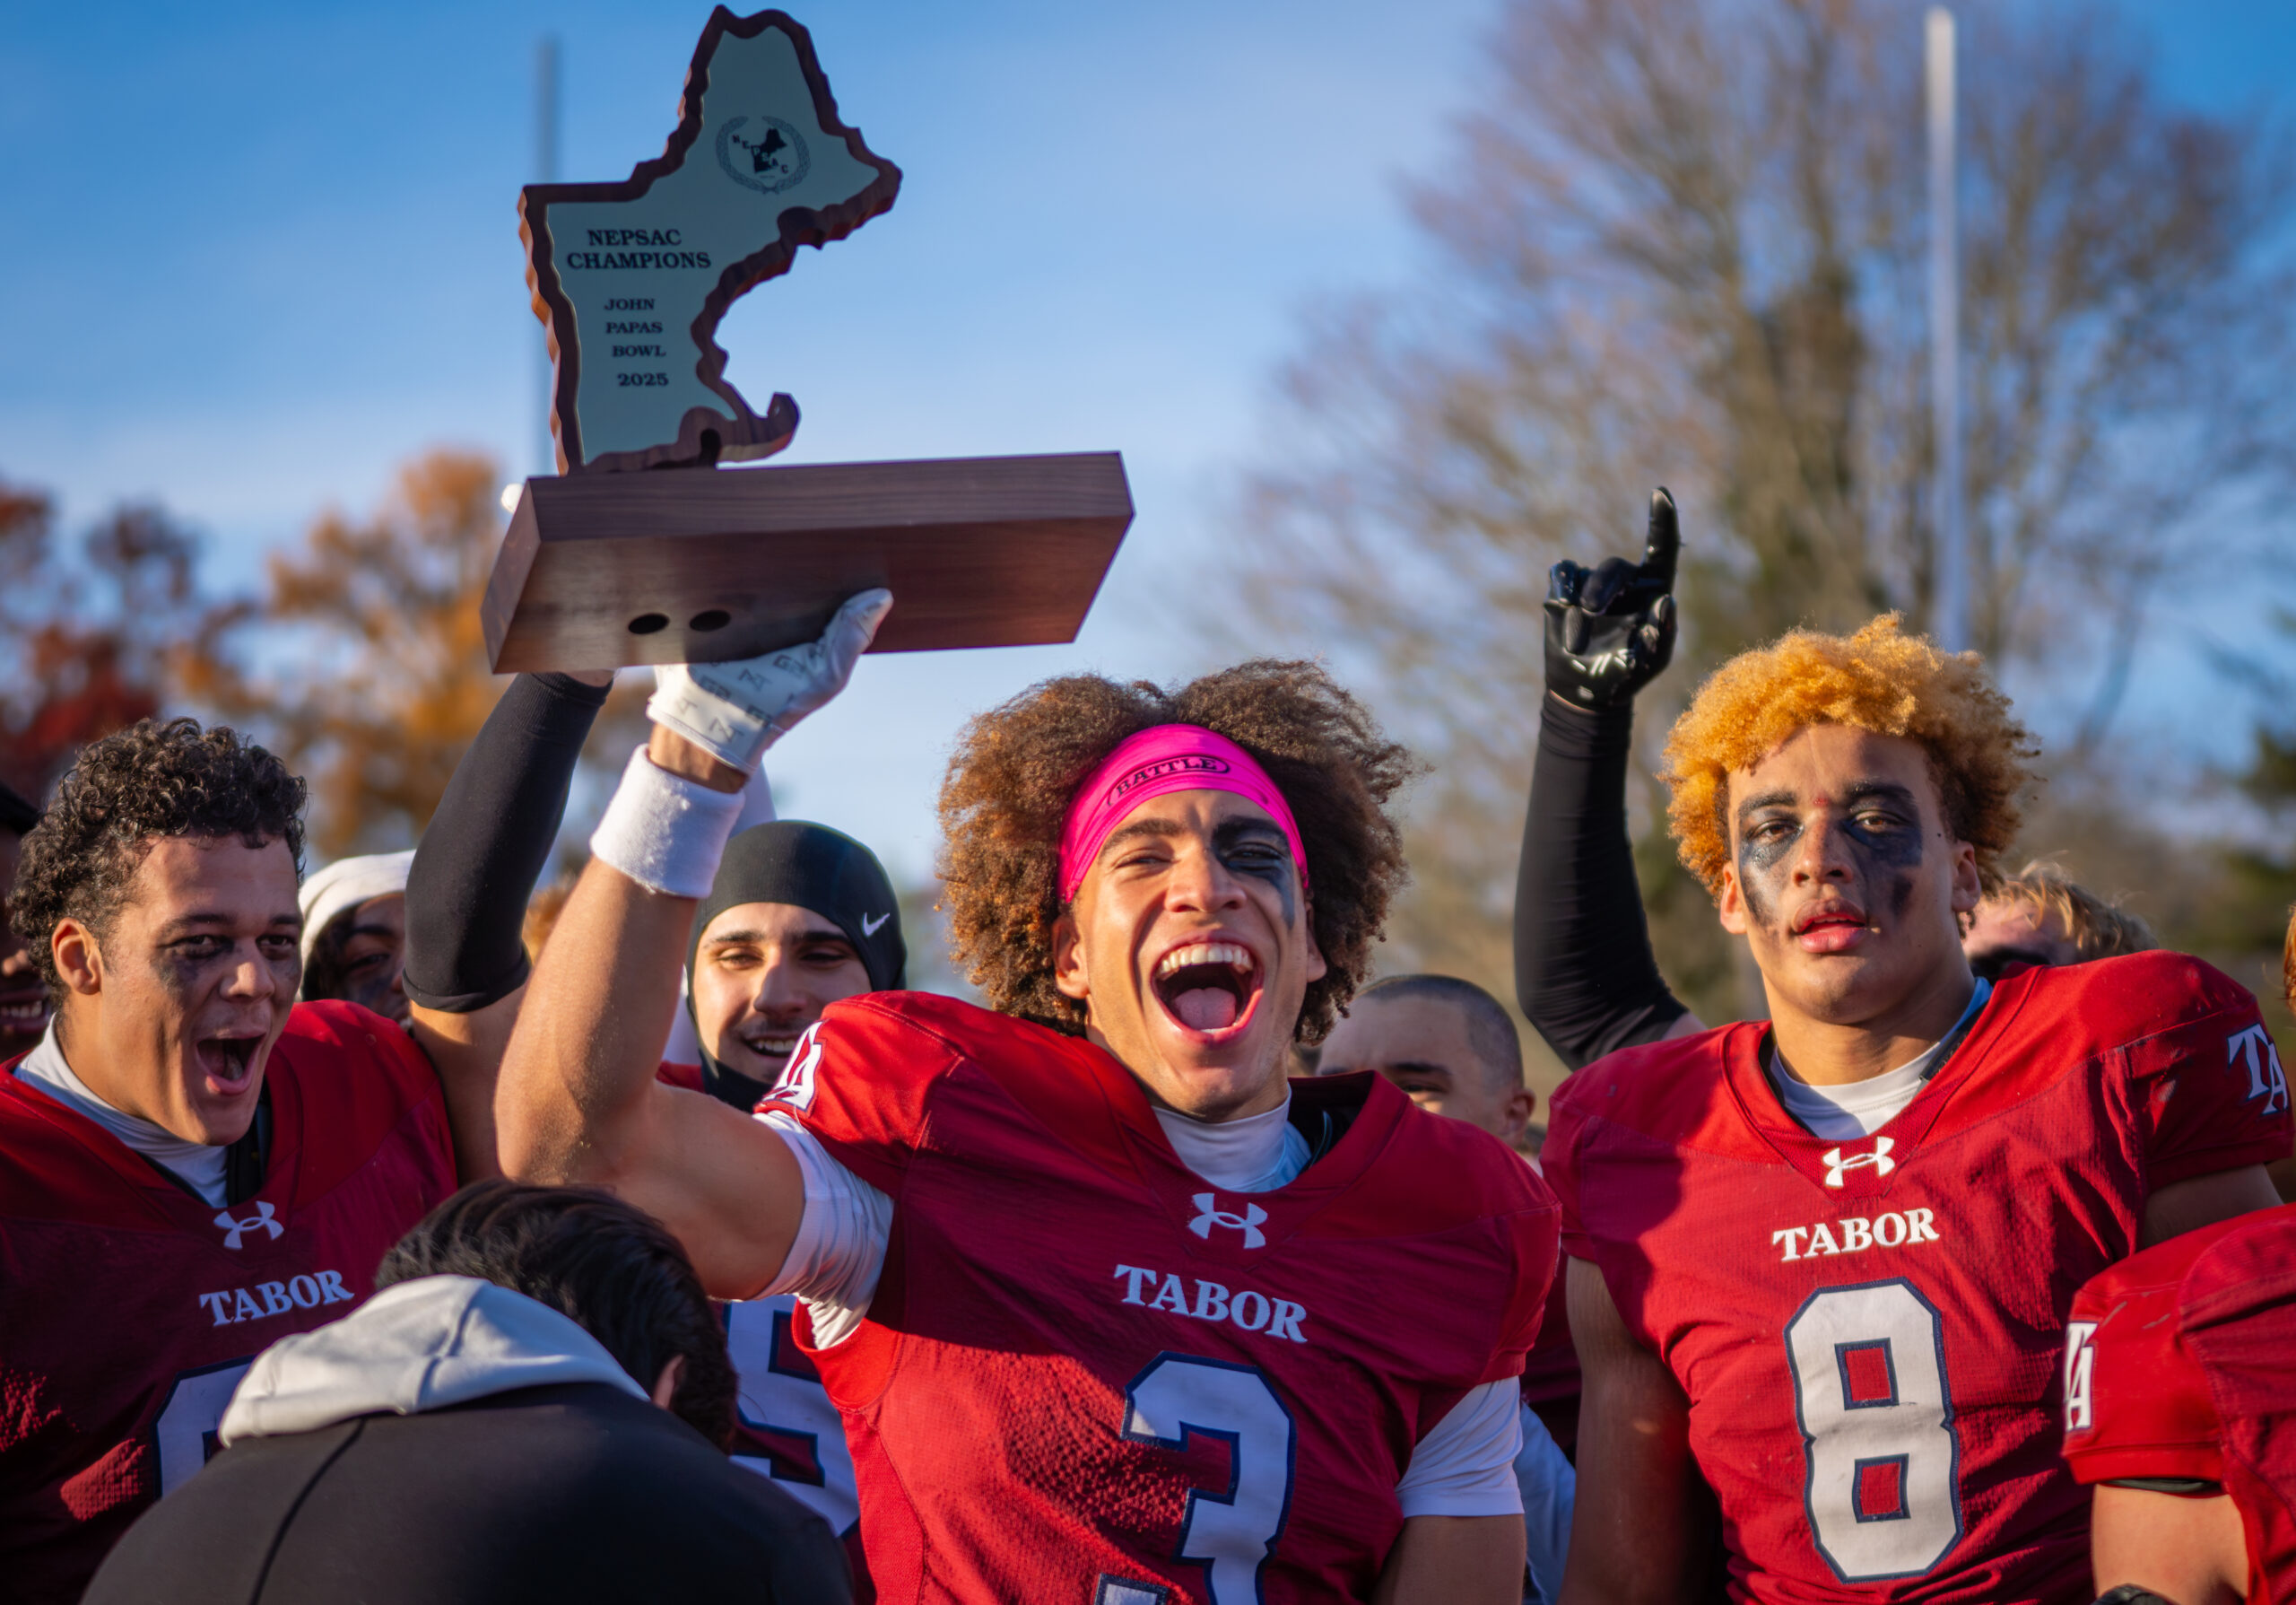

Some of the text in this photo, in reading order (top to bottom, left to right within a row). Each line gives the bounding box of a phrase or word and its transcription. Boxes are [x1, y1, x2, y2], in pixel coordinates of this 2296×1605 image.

[587, 229, 683, 247] NEPSAC
[567, 251, 712, 269] CHAMPIONS
[604, 298, 656, 310] JOHN
[605, 321, 664, 334] PAPAS
[612, 345, 666, 358] BOWL
[617, 372, 669, 388] 2025
[1116, 757, 1218, 796] BATTLE
[1772, 1208, 1940, 1262] TABOR
[198, 1269, 355, 1328] TABOR
[1113, 1263, 1309, 1344] TABOR
[1783, 1276, 1965, 1584] 8
[1093, 1350, 1298, 1605] 3
